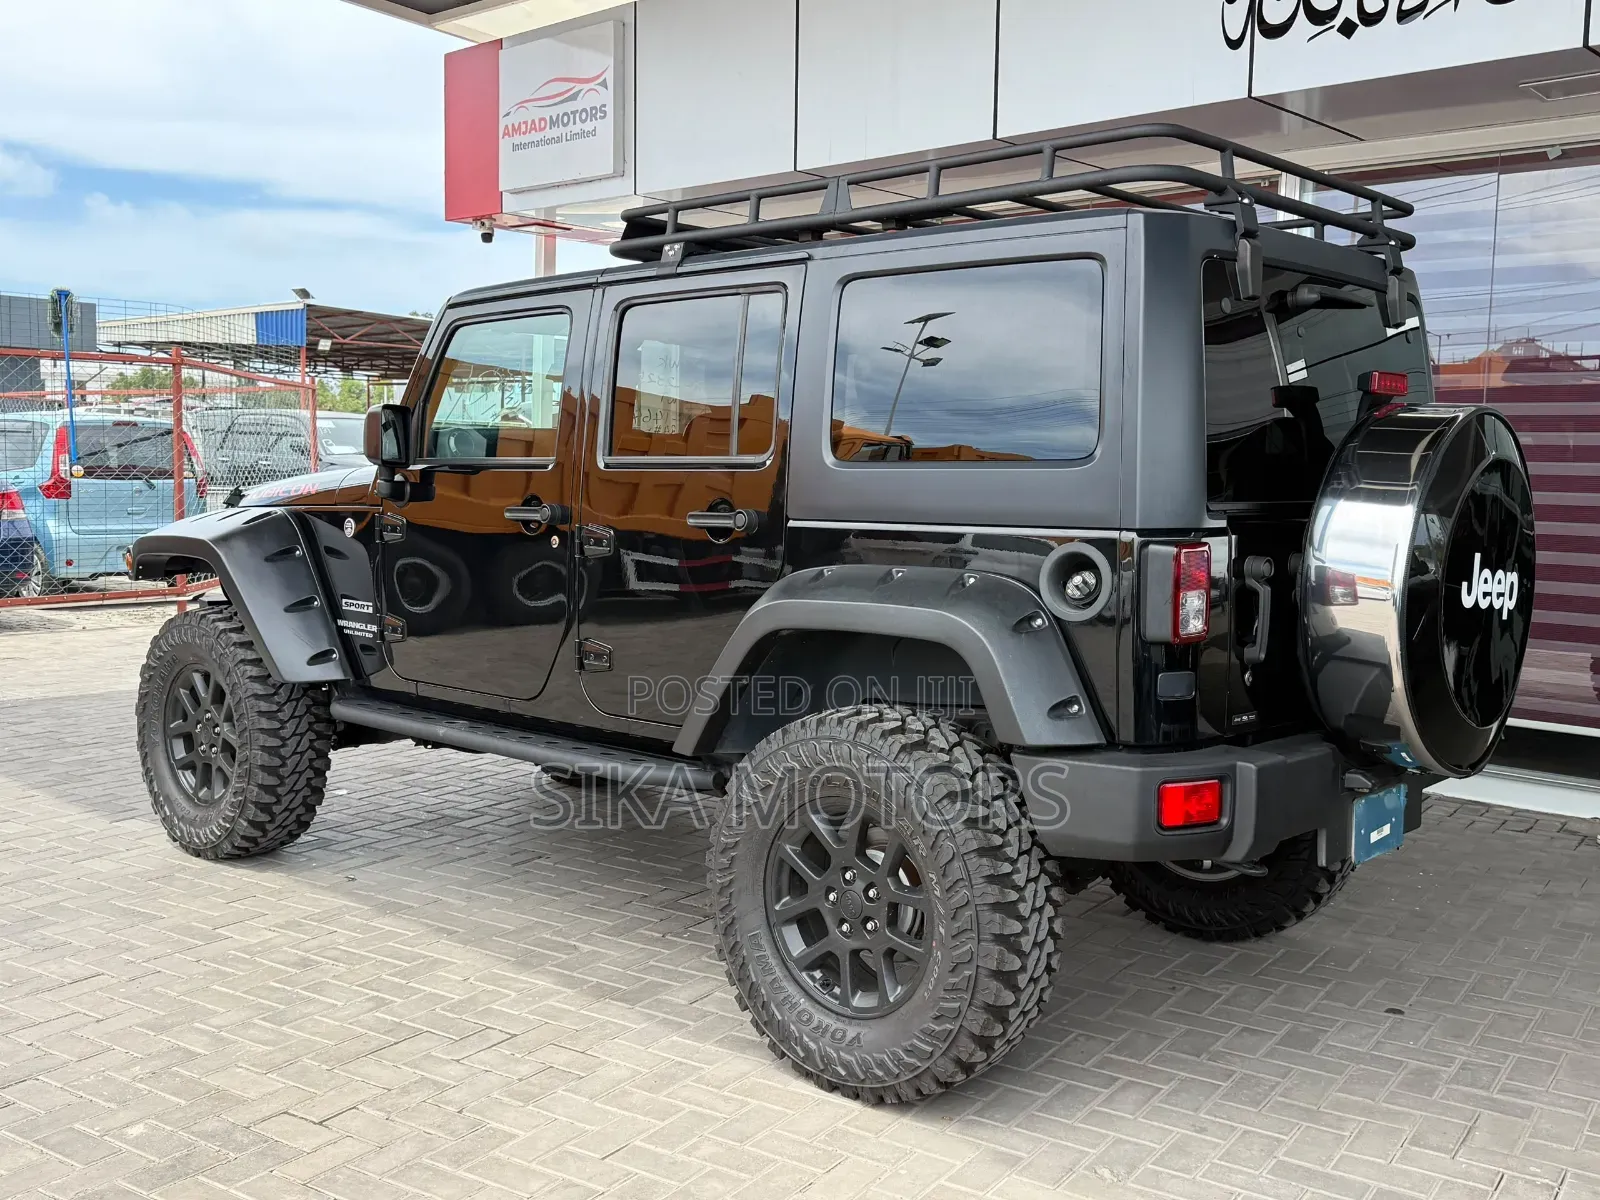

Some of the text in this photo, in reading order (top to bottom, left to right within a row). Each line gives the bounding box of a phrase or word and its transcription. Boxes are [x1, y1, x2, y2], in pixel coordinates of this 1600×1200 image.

[501, 103, 607, 140] AMJAD MOTORS
[511, 126, 597, 152] International Limited
[1461, 552, 1519, 620] Jeep
[344, 601, 371, 611] SPORT
[336, 618, 377, 633] WRANGLER
[343, 628, 374, 638] UNLIMITED
[150, 654, 179, 747] YOKOHAMA
[746, 930, 864, 1048] YOKOHAMA
